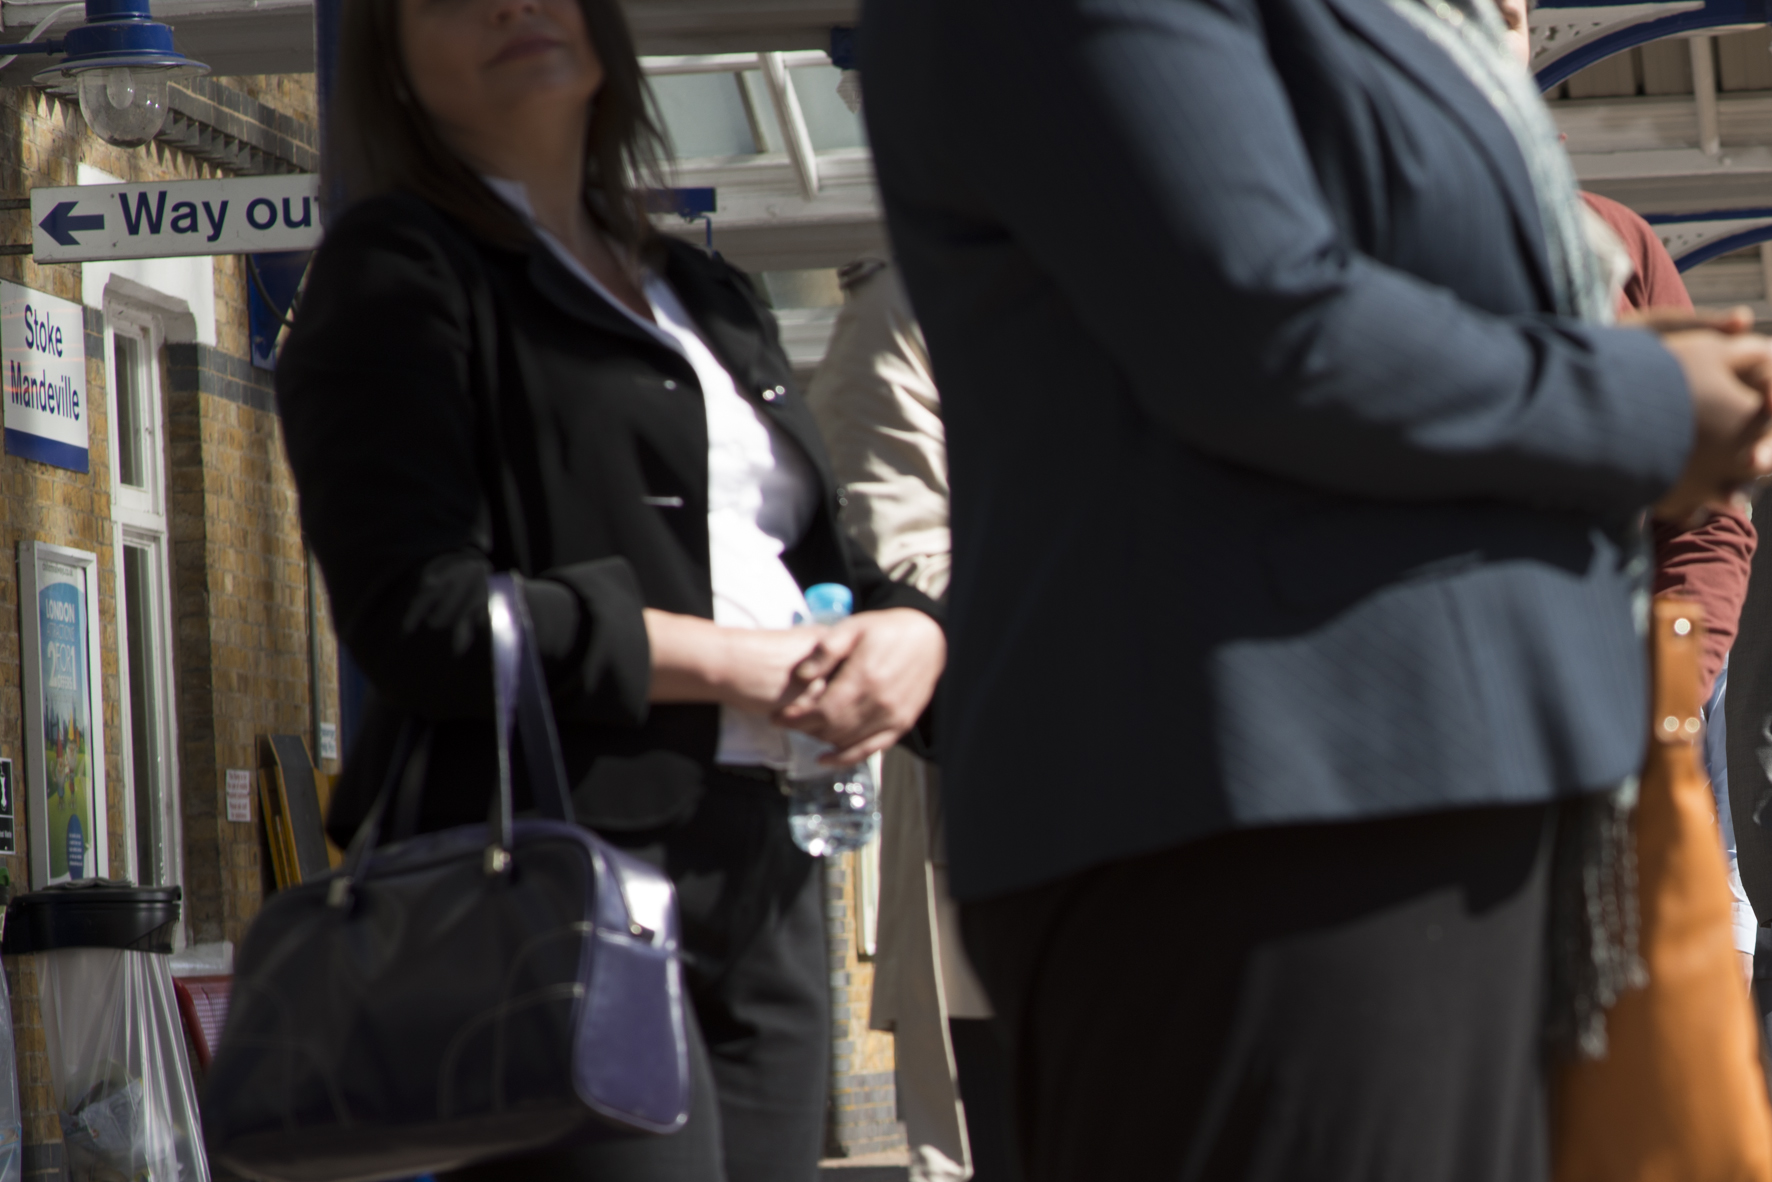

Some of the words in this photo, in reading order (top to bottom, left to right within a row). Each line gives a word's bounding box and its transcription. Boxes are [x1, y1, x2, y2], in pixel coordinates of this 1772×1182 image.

[118, 191, 230, 242] Way
[24, 303, 63, 358] Stoke
[11, 359, 80, 421] Mandeville
[45, 598, 75, 624] LONDON
